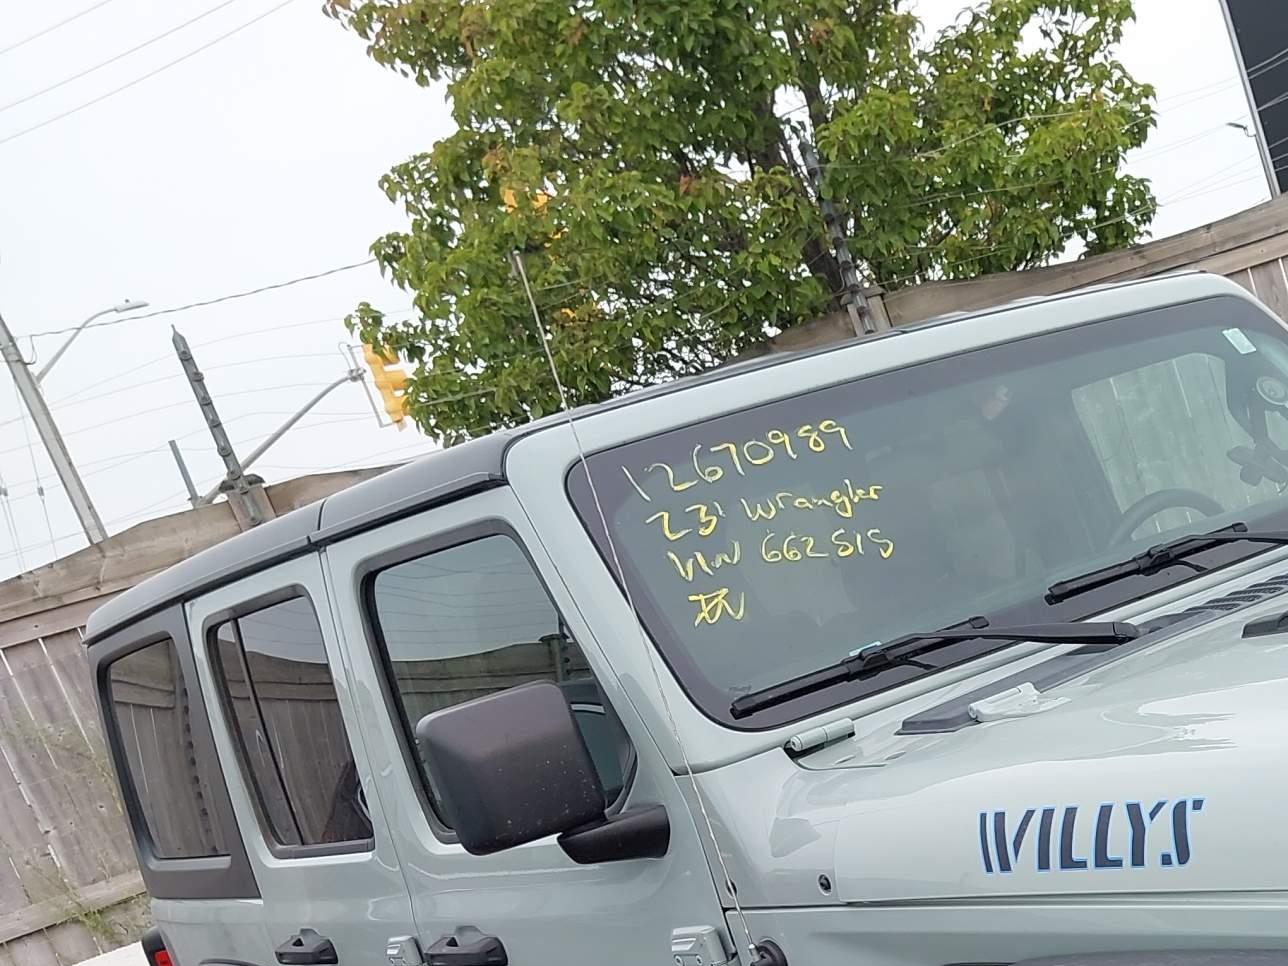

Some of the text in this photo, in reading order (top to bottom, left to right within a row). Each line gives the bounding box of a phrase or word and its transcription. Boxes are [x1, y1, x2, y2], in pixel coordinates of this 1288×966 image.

[621, 419, 854, 502] 12670989
[741, 478, 883, 519] Wrangler
[977, 796, 1206, 874] WILLYS
